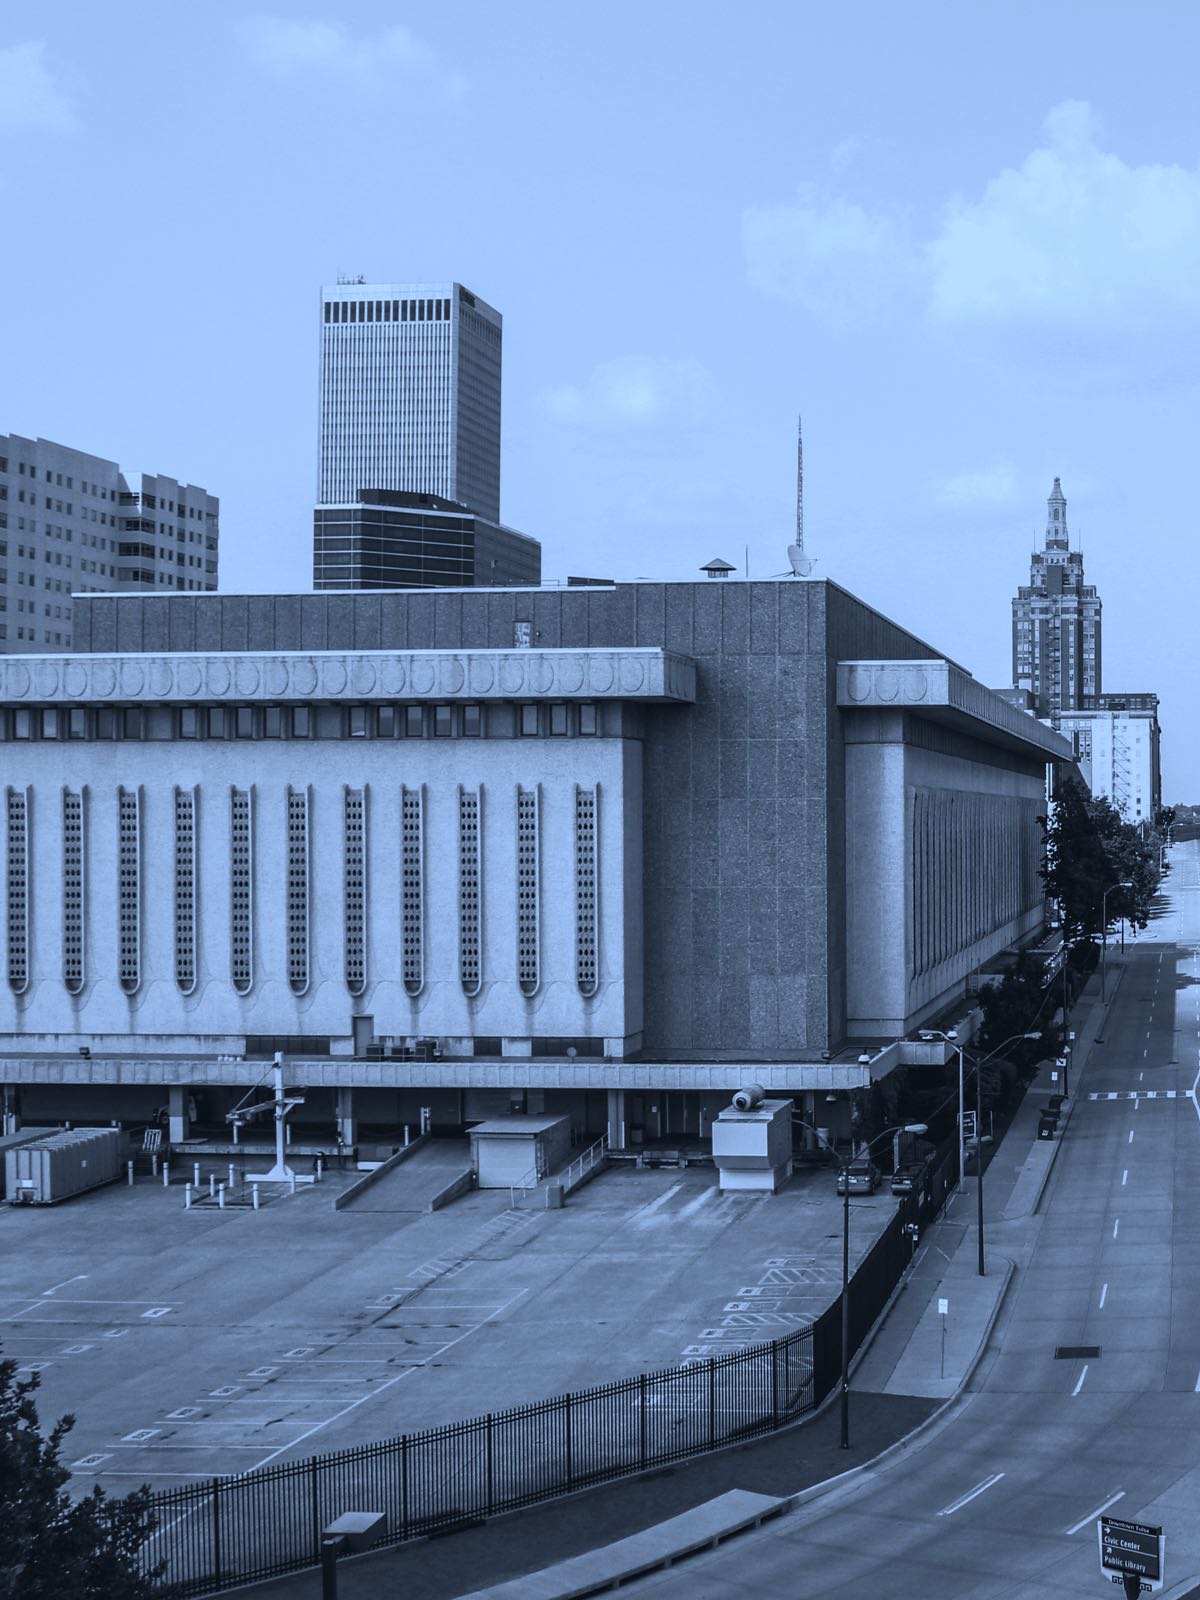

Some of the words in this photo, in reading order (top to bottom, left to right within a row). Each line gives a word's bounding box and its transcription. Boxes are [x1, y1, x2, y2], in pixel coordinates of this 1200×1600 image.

[1109, 1519, 1135, 1531] Downtown
[1136, 1525, 1150, 1534] Tulsa
[1104, 1536, 1119, 1546] Civic
[1120, 1540, 1141, 1551] Center
[1104, 1556, 1123, 1567] Public
[1125, 1560, 1146, 1573] Library
